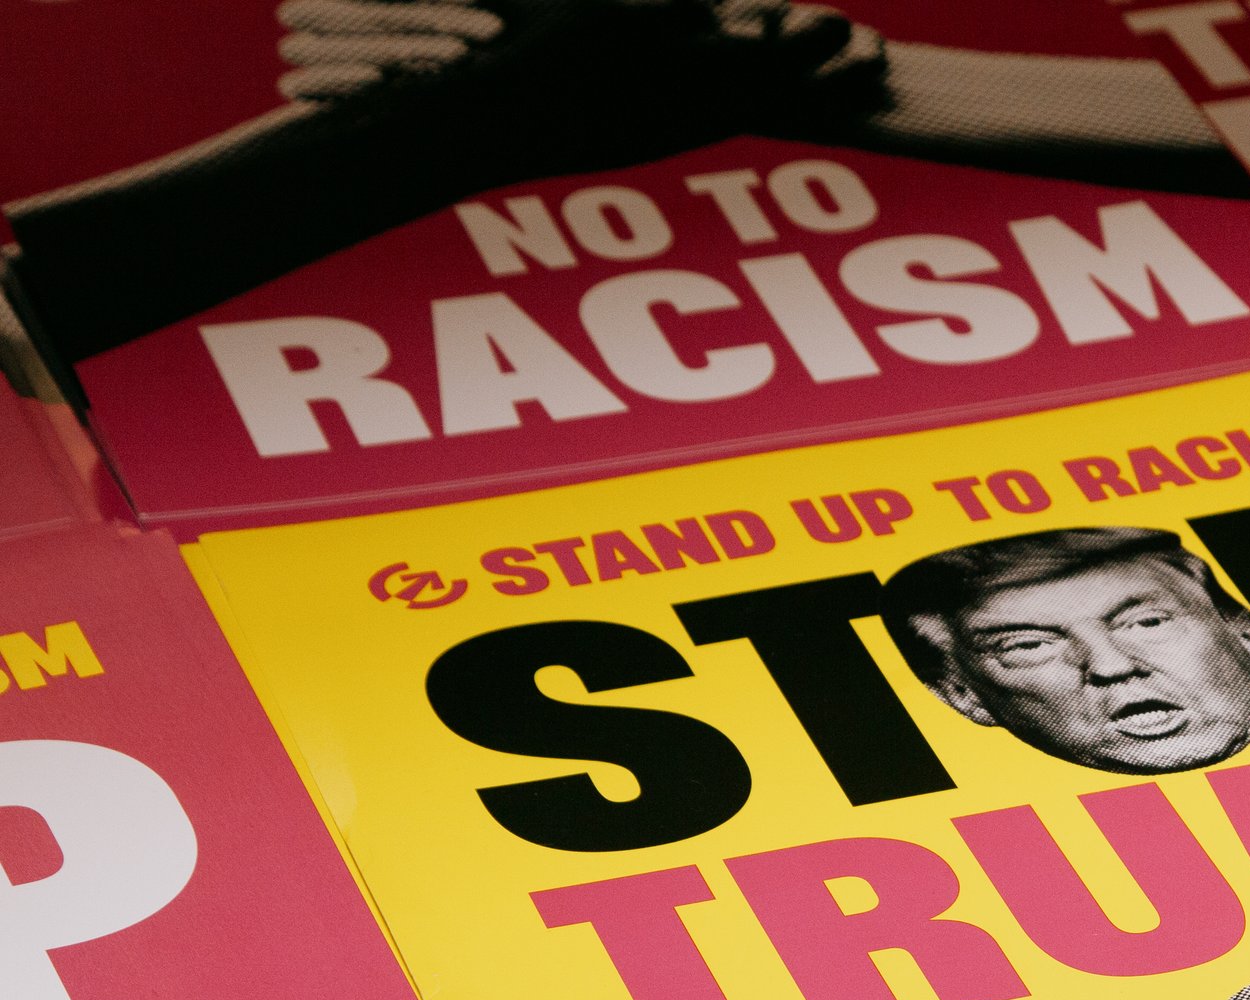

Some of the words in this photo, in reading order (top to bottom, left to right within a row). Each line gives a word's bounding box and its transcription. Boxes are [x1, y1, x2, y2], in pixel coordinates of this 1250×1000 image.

[453, 185, 674, 276] NO
[684, 160, 879, 244] TO
[480, 510, 777, 596] STAND
[790, 489, 913, 544] UP
[932, 469, 1052, 522] TO
[0, 620, 105, 694] M
